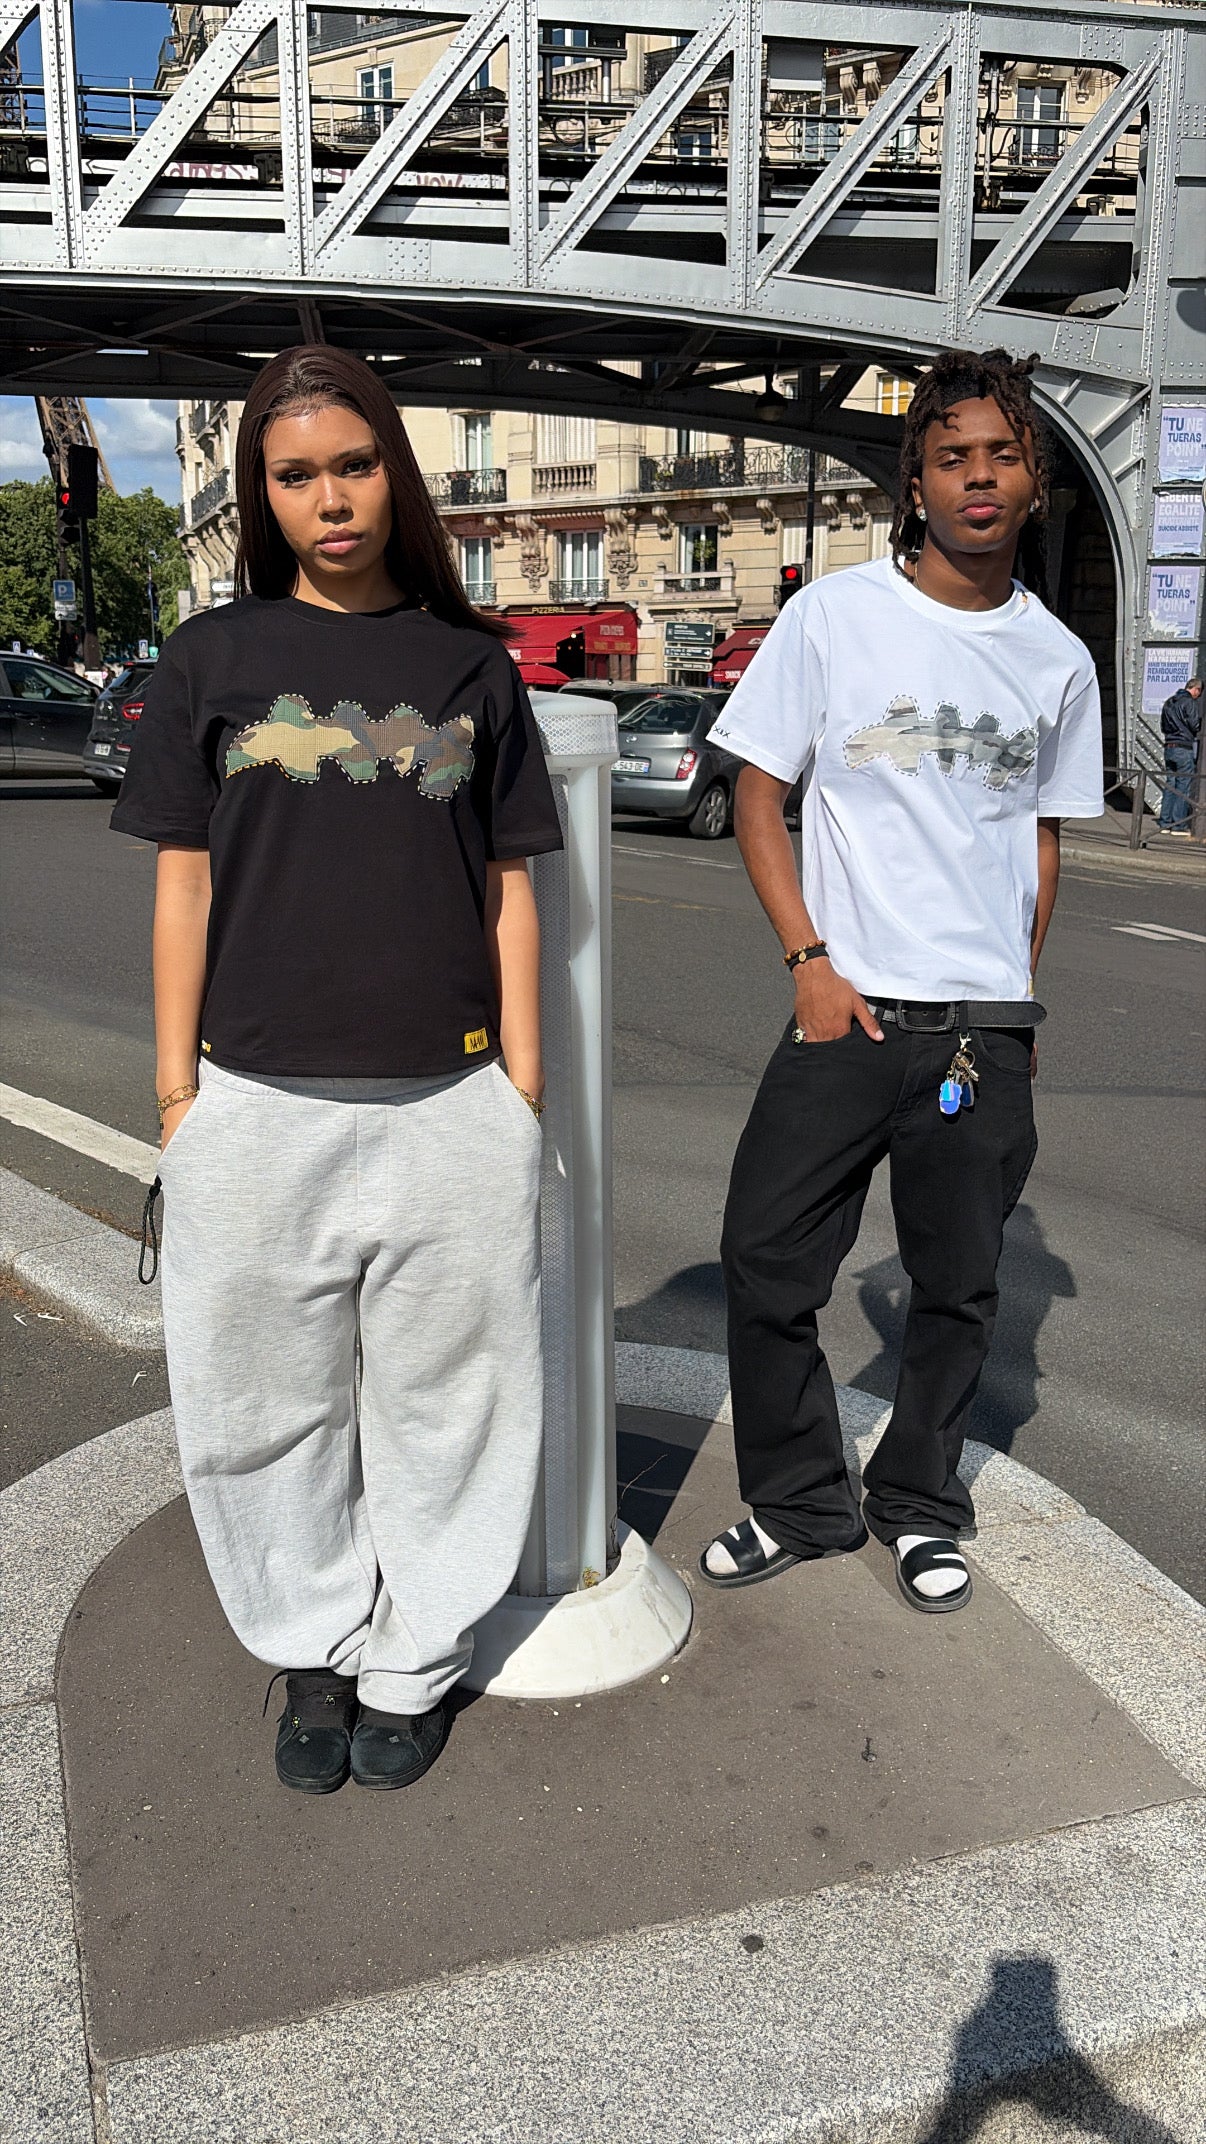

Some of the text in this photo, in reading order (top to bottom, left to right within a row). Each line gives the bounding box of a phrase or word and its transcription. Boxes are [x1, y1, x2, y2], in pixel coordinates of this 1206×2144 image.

[1186, 417, 1203, 432] NE
[1168, 432, 1202, 443] TUERAS
[1175, 574, 1192, 588] NE
[1157, 589, 1190, 599] TUERAS
[531, 606, 566, 614] PIZZERIA
